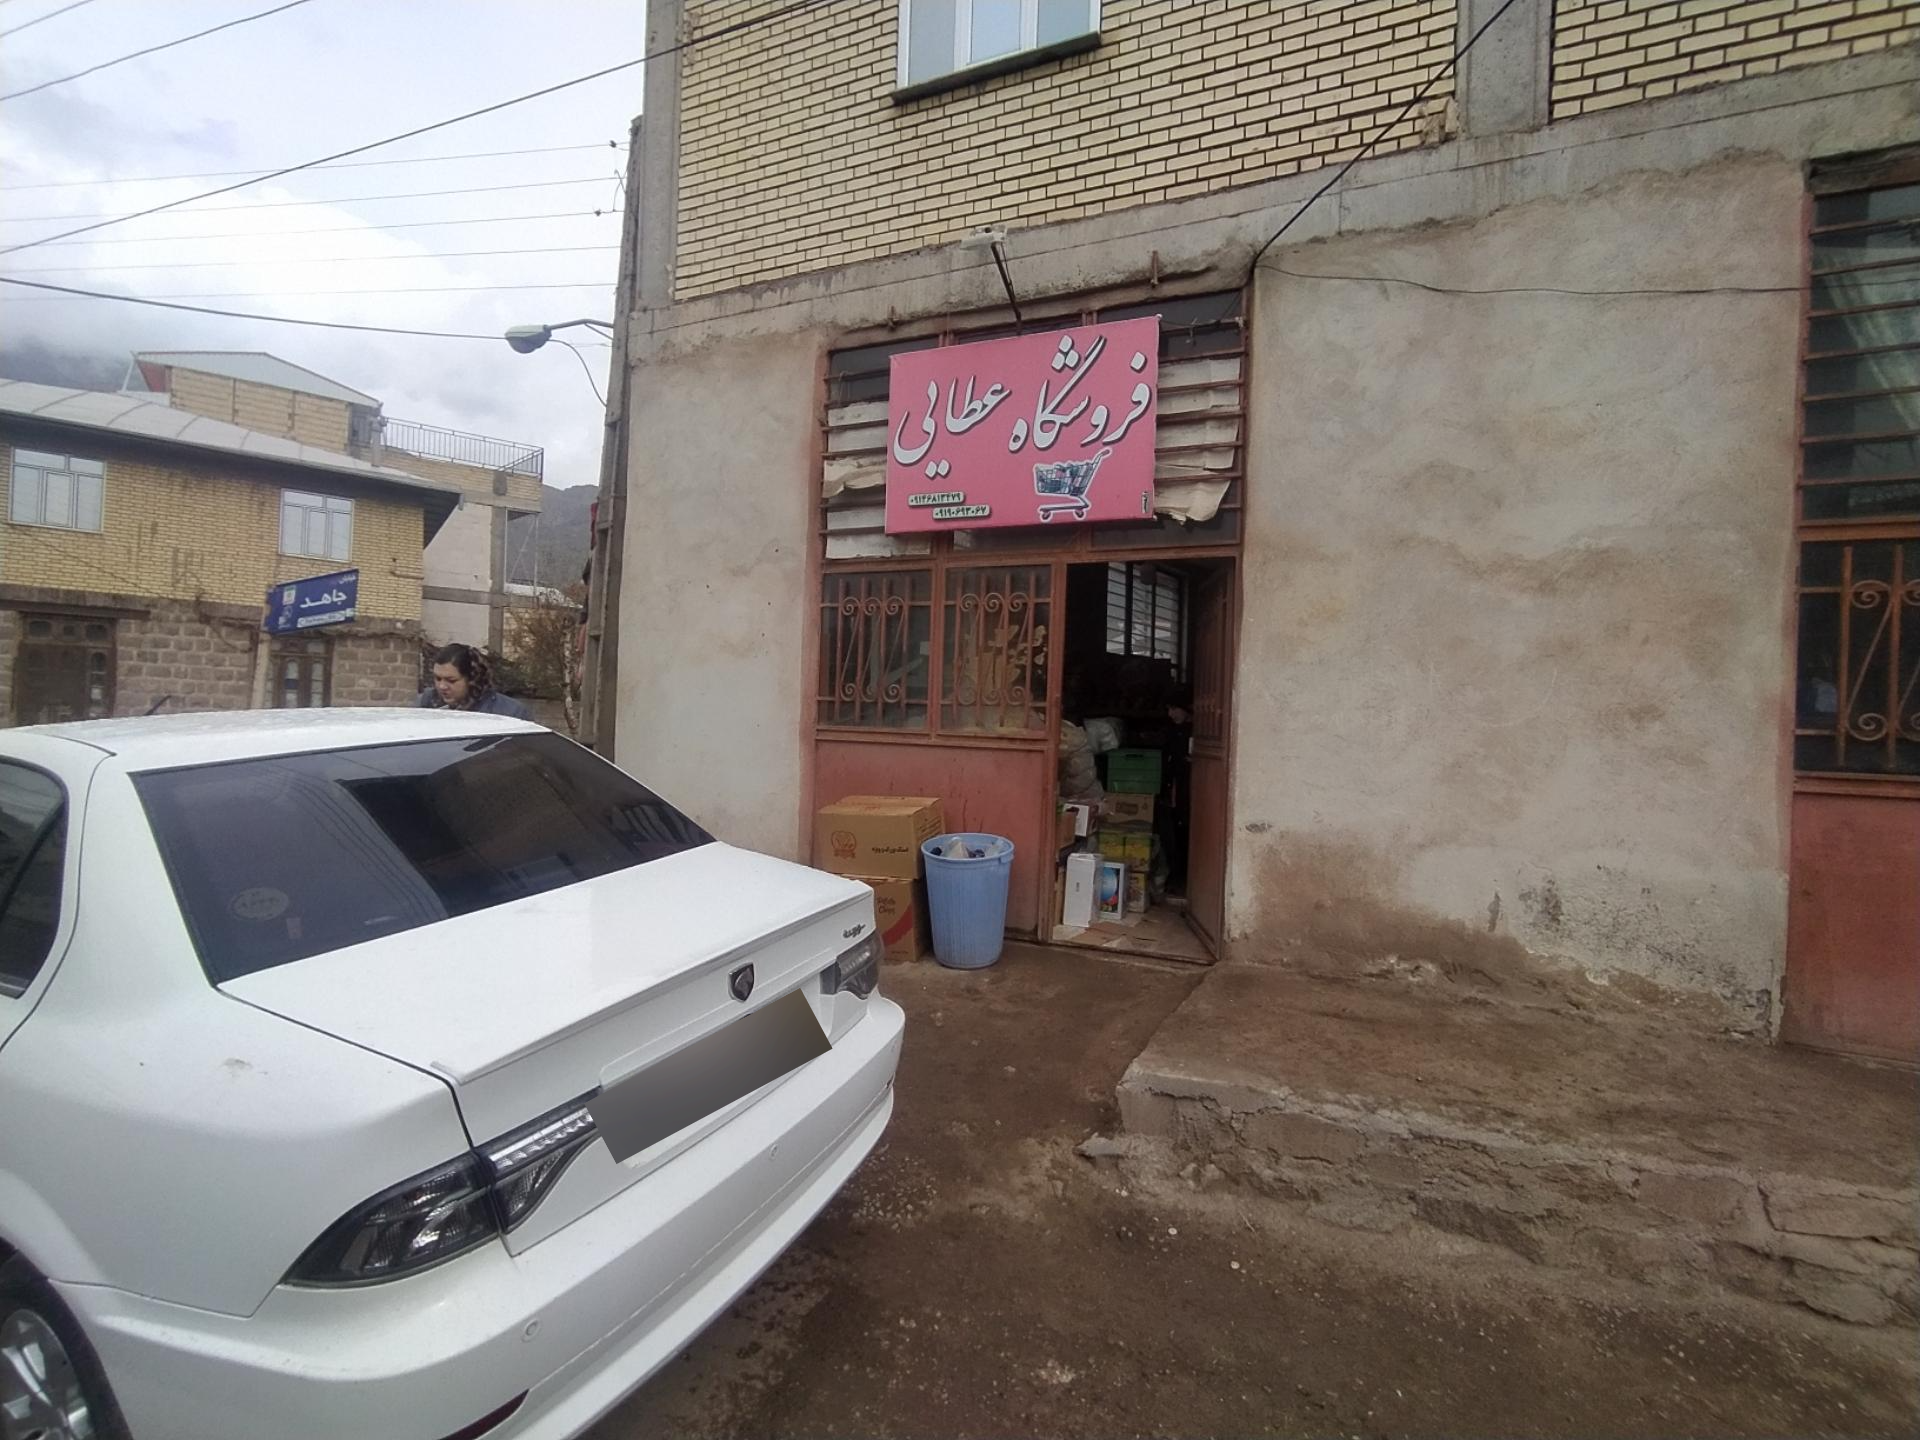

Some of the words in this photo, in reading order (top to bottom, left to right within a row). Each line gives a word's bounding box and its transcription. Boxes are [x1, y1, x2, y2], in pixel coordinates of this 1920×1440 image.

[893, 375, 1012, 480] عطایی
[1008, 335, 1152, 453] فروشگاه
[299, 588, 348, 608] جاهد
